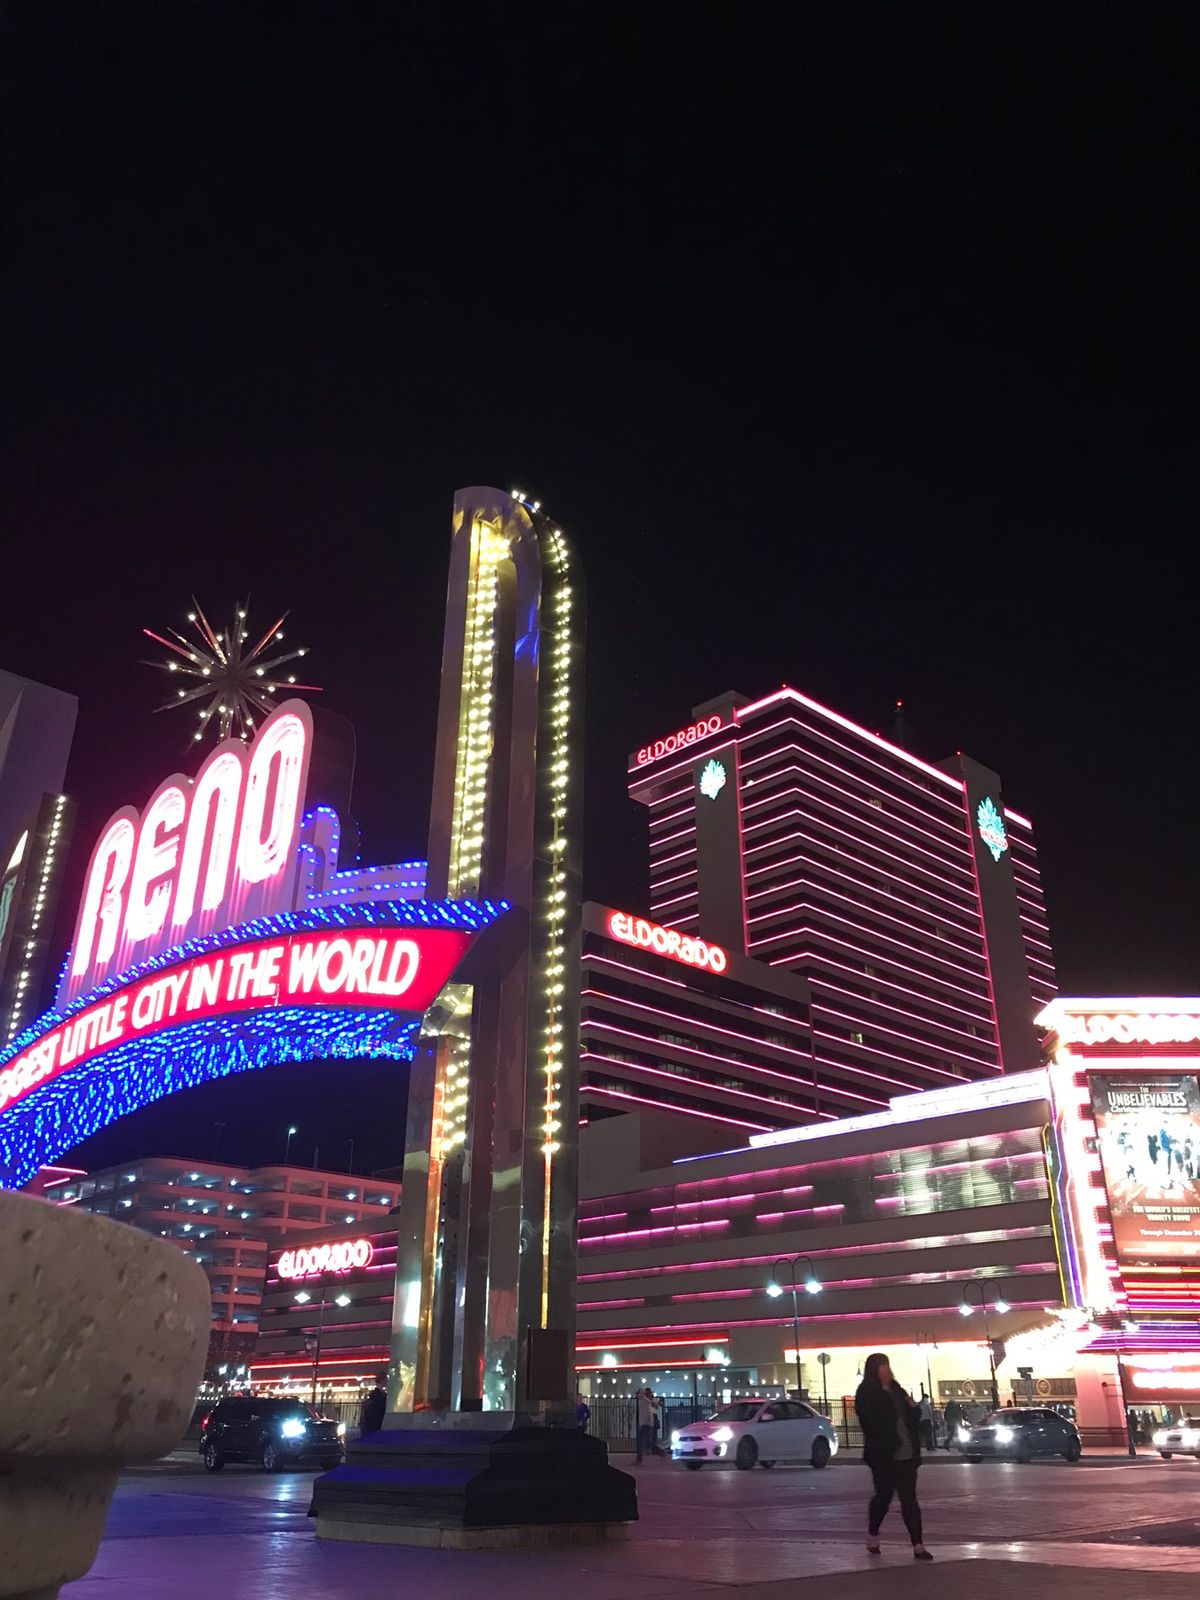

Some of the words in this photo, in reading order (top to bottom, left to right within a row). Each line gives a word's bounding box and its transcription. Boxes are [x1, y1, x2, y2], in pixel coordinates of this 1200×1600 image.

[71, 713, 305, 977] RENO
[59, 997, 128, 1067] LITTLE
[131, 970, 189, 1030] CITY
[186, 959, 224, 1012] IN
[226, 946, 284, 1002] THE
[288, 938, 419, 996] WORLD
[1107, 1091, 1188, 1107] UNBELIEVABLES
